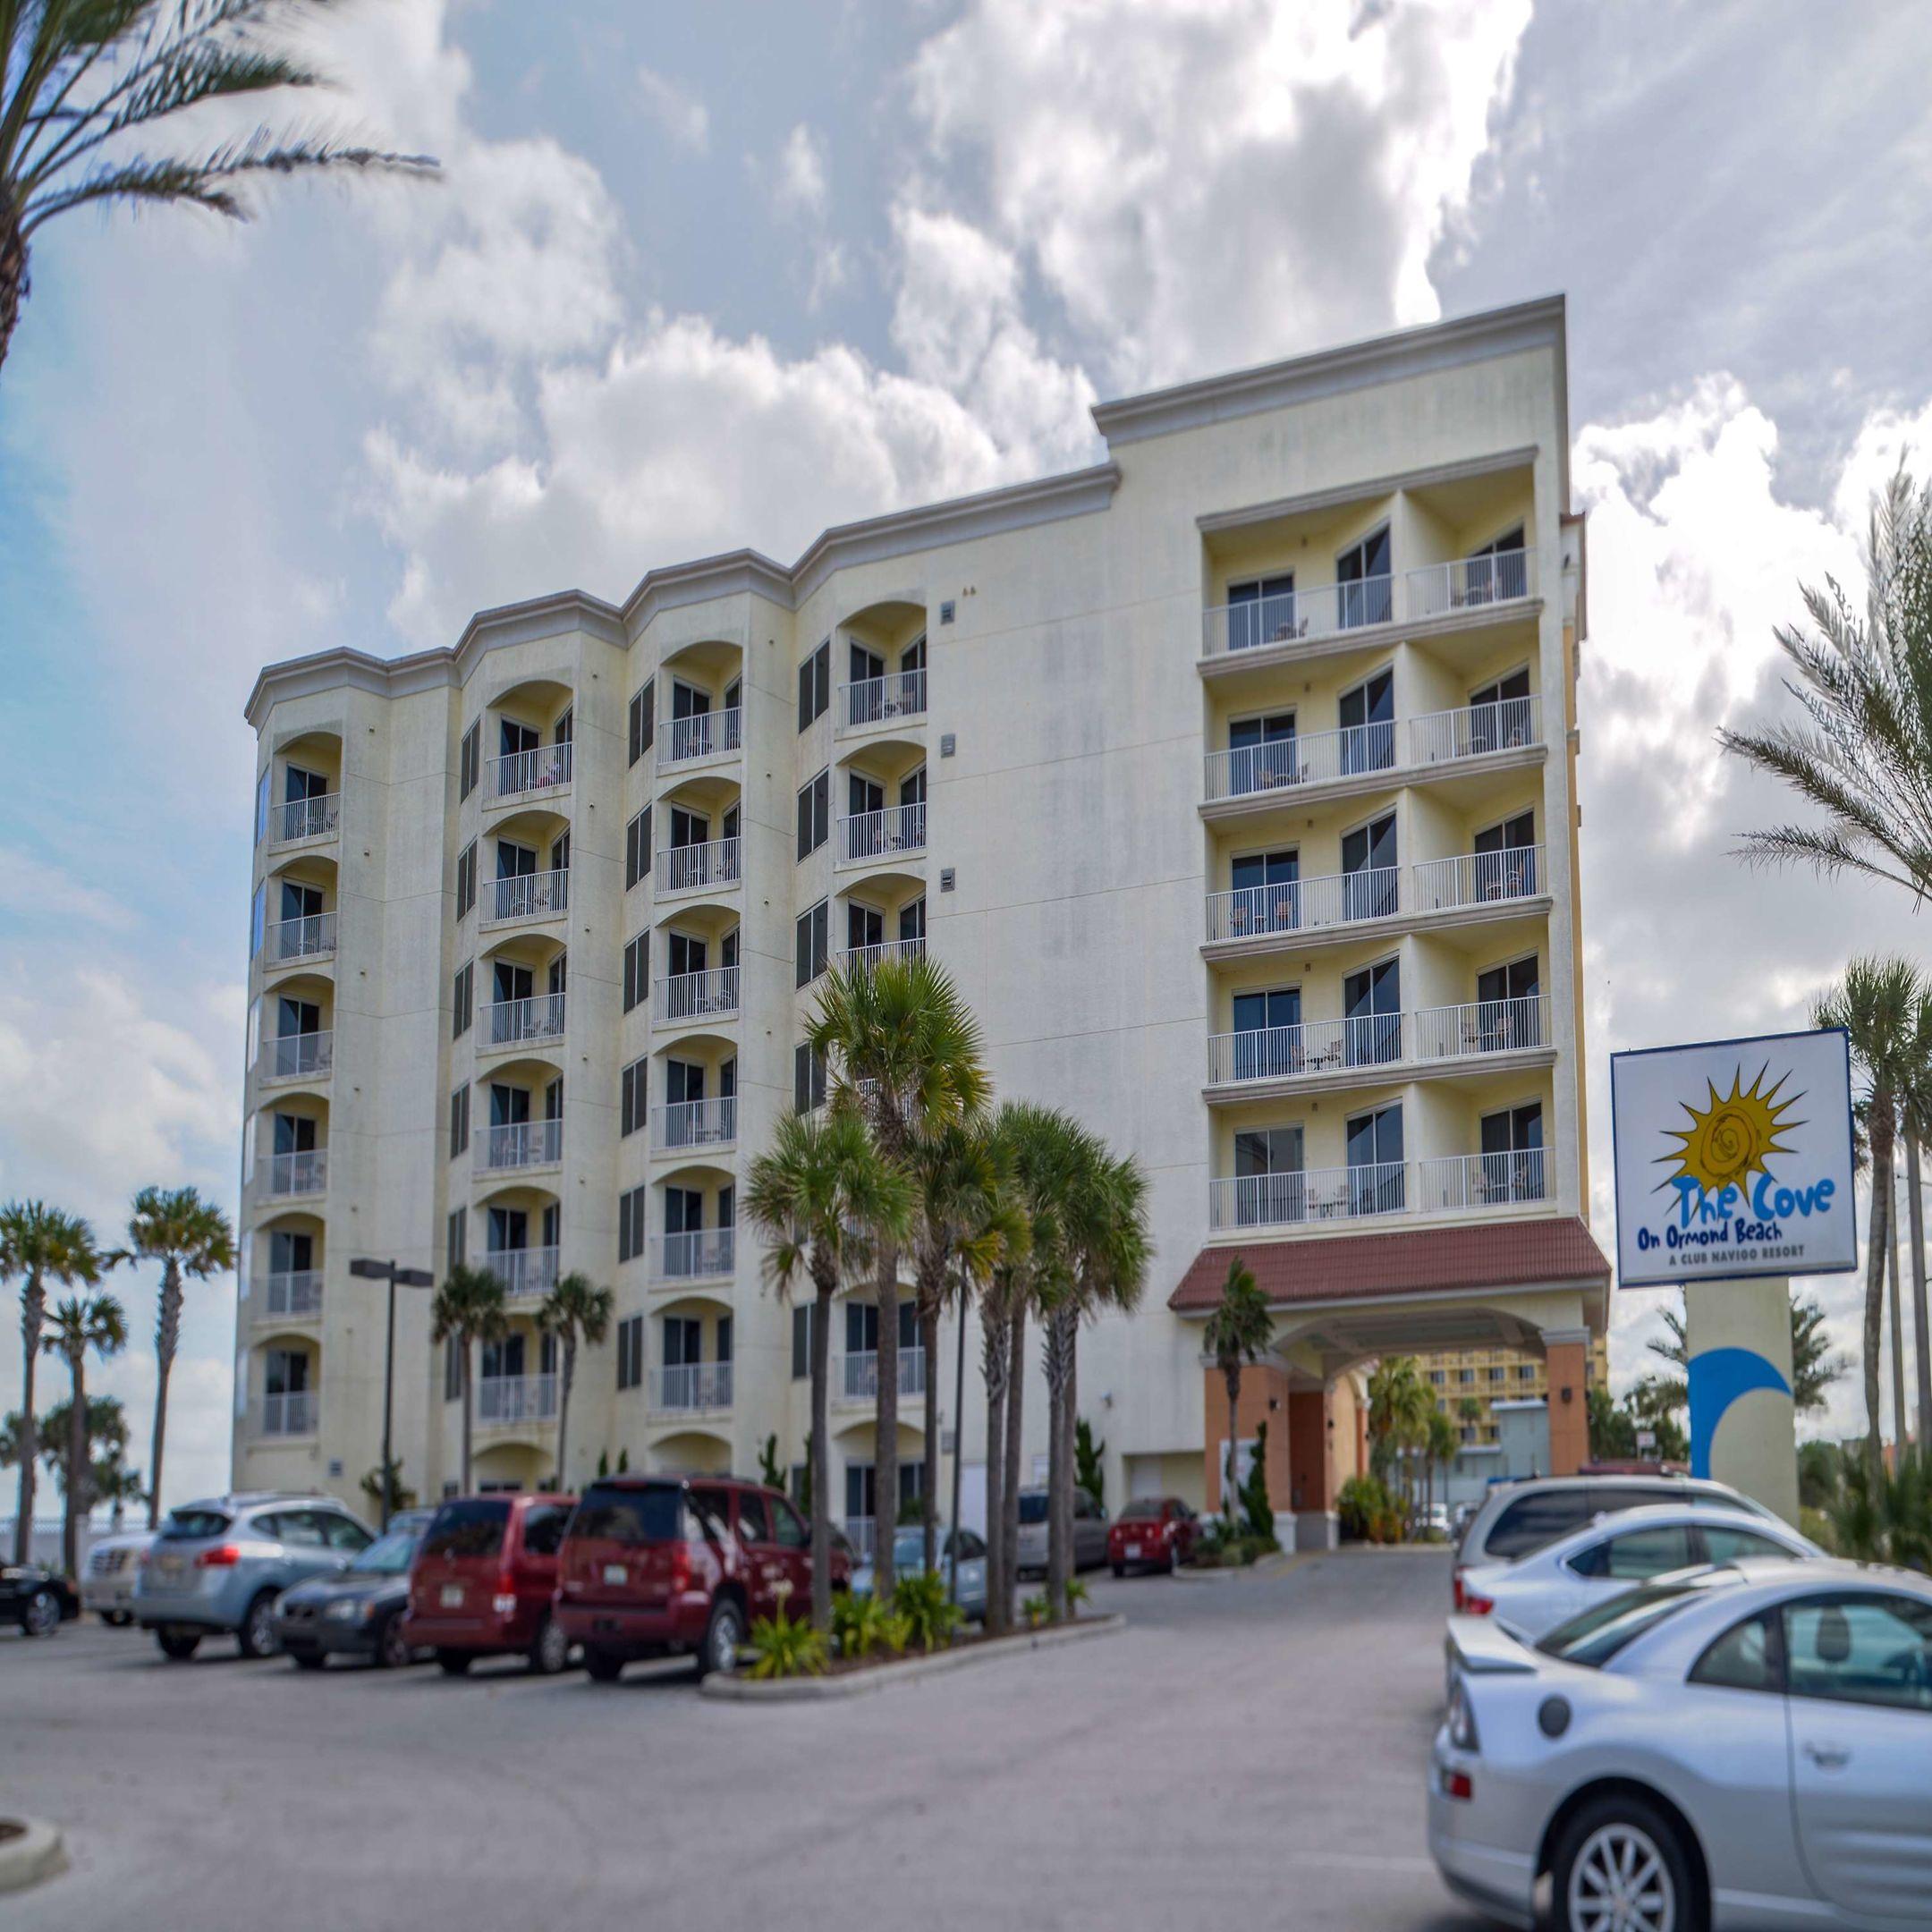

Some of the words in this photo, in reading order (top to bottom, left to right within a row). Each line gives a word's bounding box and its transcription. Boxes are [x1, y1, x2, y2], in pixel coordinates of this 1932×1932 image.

[1672, 1176, 1738, 1228] The
[1753, 1173, 1835, 1222] Cove
[1638, 1227, 1661, 1250] On
[1666, 1221, 1728, 1250] Ormond
[1735, 1217, 1783, 1243] Beach
[1669, 1255, 1676, 1266] A
[1682, 1251, 1707, 1265] CLUB
[1762, 1245, 1805, 1259] RESORT
